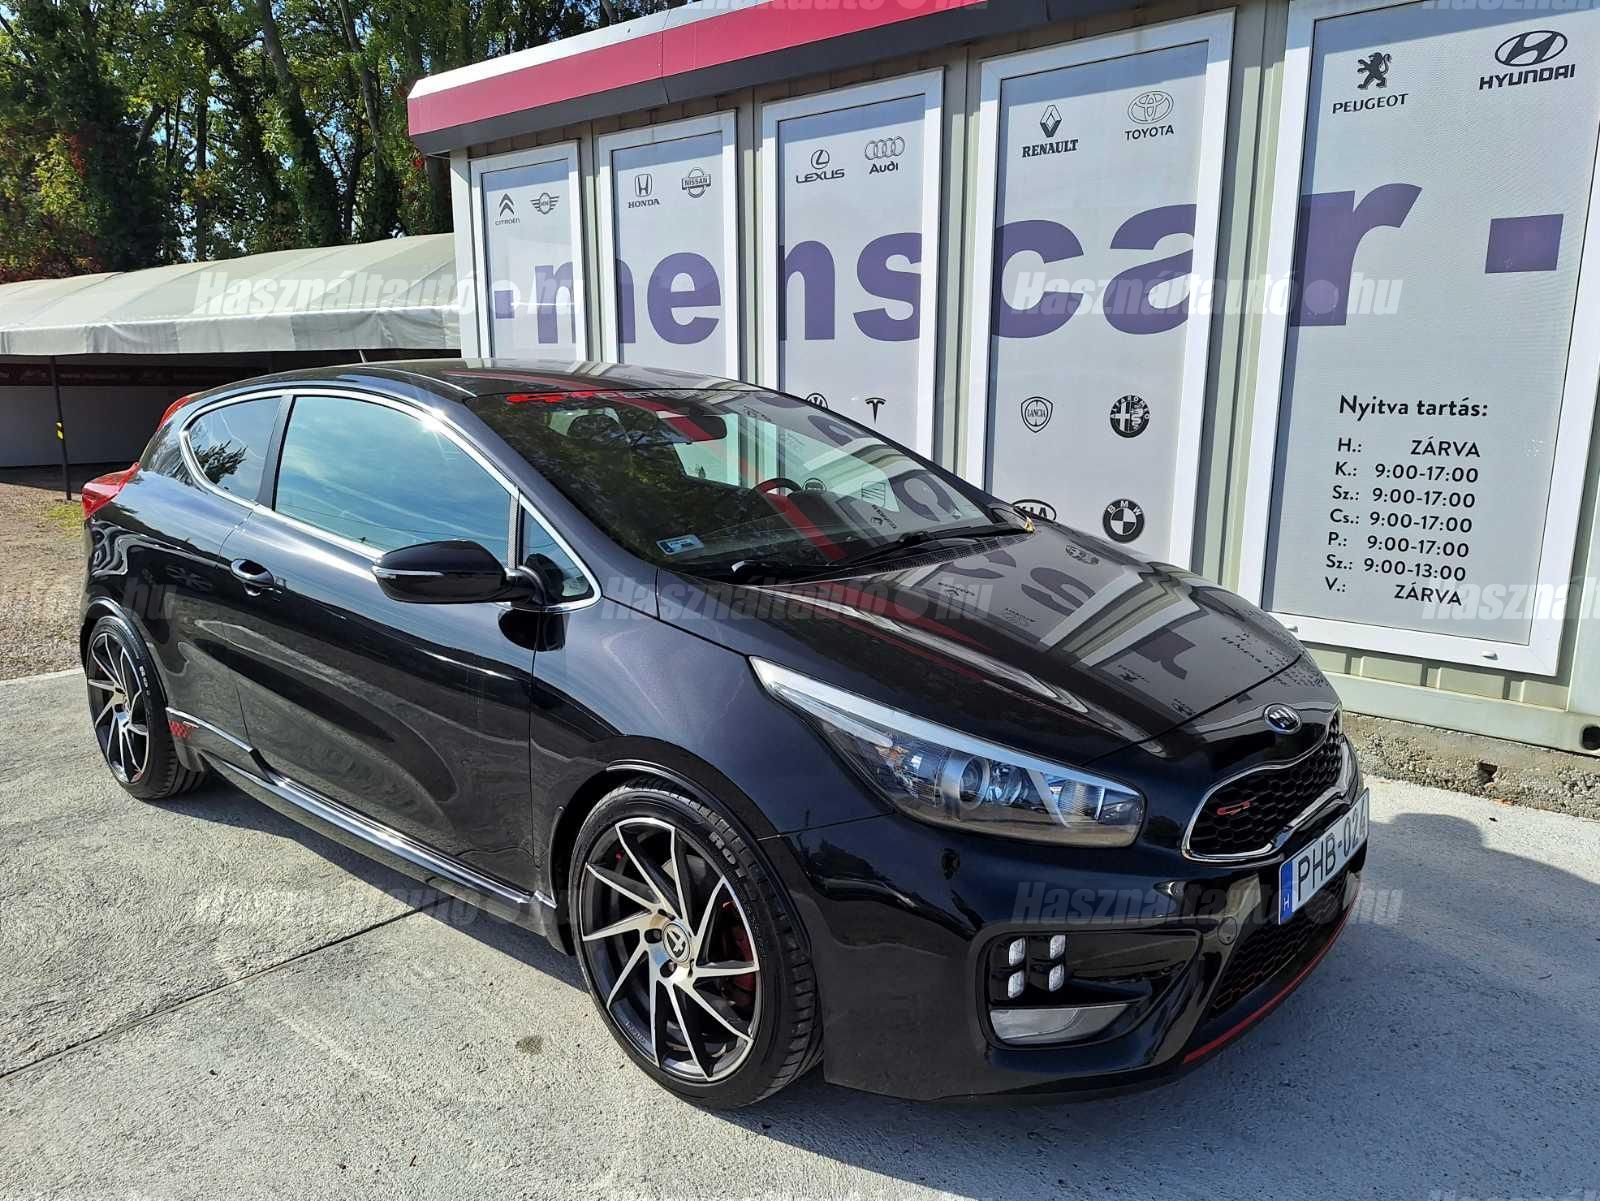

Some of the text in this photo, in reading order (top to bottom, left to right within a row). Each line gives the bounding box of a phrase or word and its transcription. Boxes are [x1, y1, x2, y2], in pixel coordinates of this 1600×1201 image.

[1479, 64, 1575, 90] HYUNDAI
[1332, 93, 1408, 114] PEUGEOT
[1125, 124, 1174, 141] TOYOTA
[1022, 138, 1079, 158] RENAULT
[796, 168, 845, 184] LEXUS
[869, 161, 899, 175] Audi
[685, 177, 708, 186] NISSAN
[628, 198, 660, 209] HONDA
[1339, 395, 1488, 421] Nyitva tartás:
[1337, 436, 1480, 458] H.: ZÁRVA
[1335, 461, 1479, 483] K.: 9:00-17:00
[1332, 485, 1475, 508] Sz.: 9:00-17:00
[1107, 500, 1142, 516] BMW
[1330, 509, 1472, 533] Cs.: 9:00-17:00
[1328, 532, 1469, 557] P.: 9:00-17:00
[1326, 554, 1466, 581] Sz.: 9:00-13:00
[1325, 577, 1462, 606] V.: ZÁRVA
